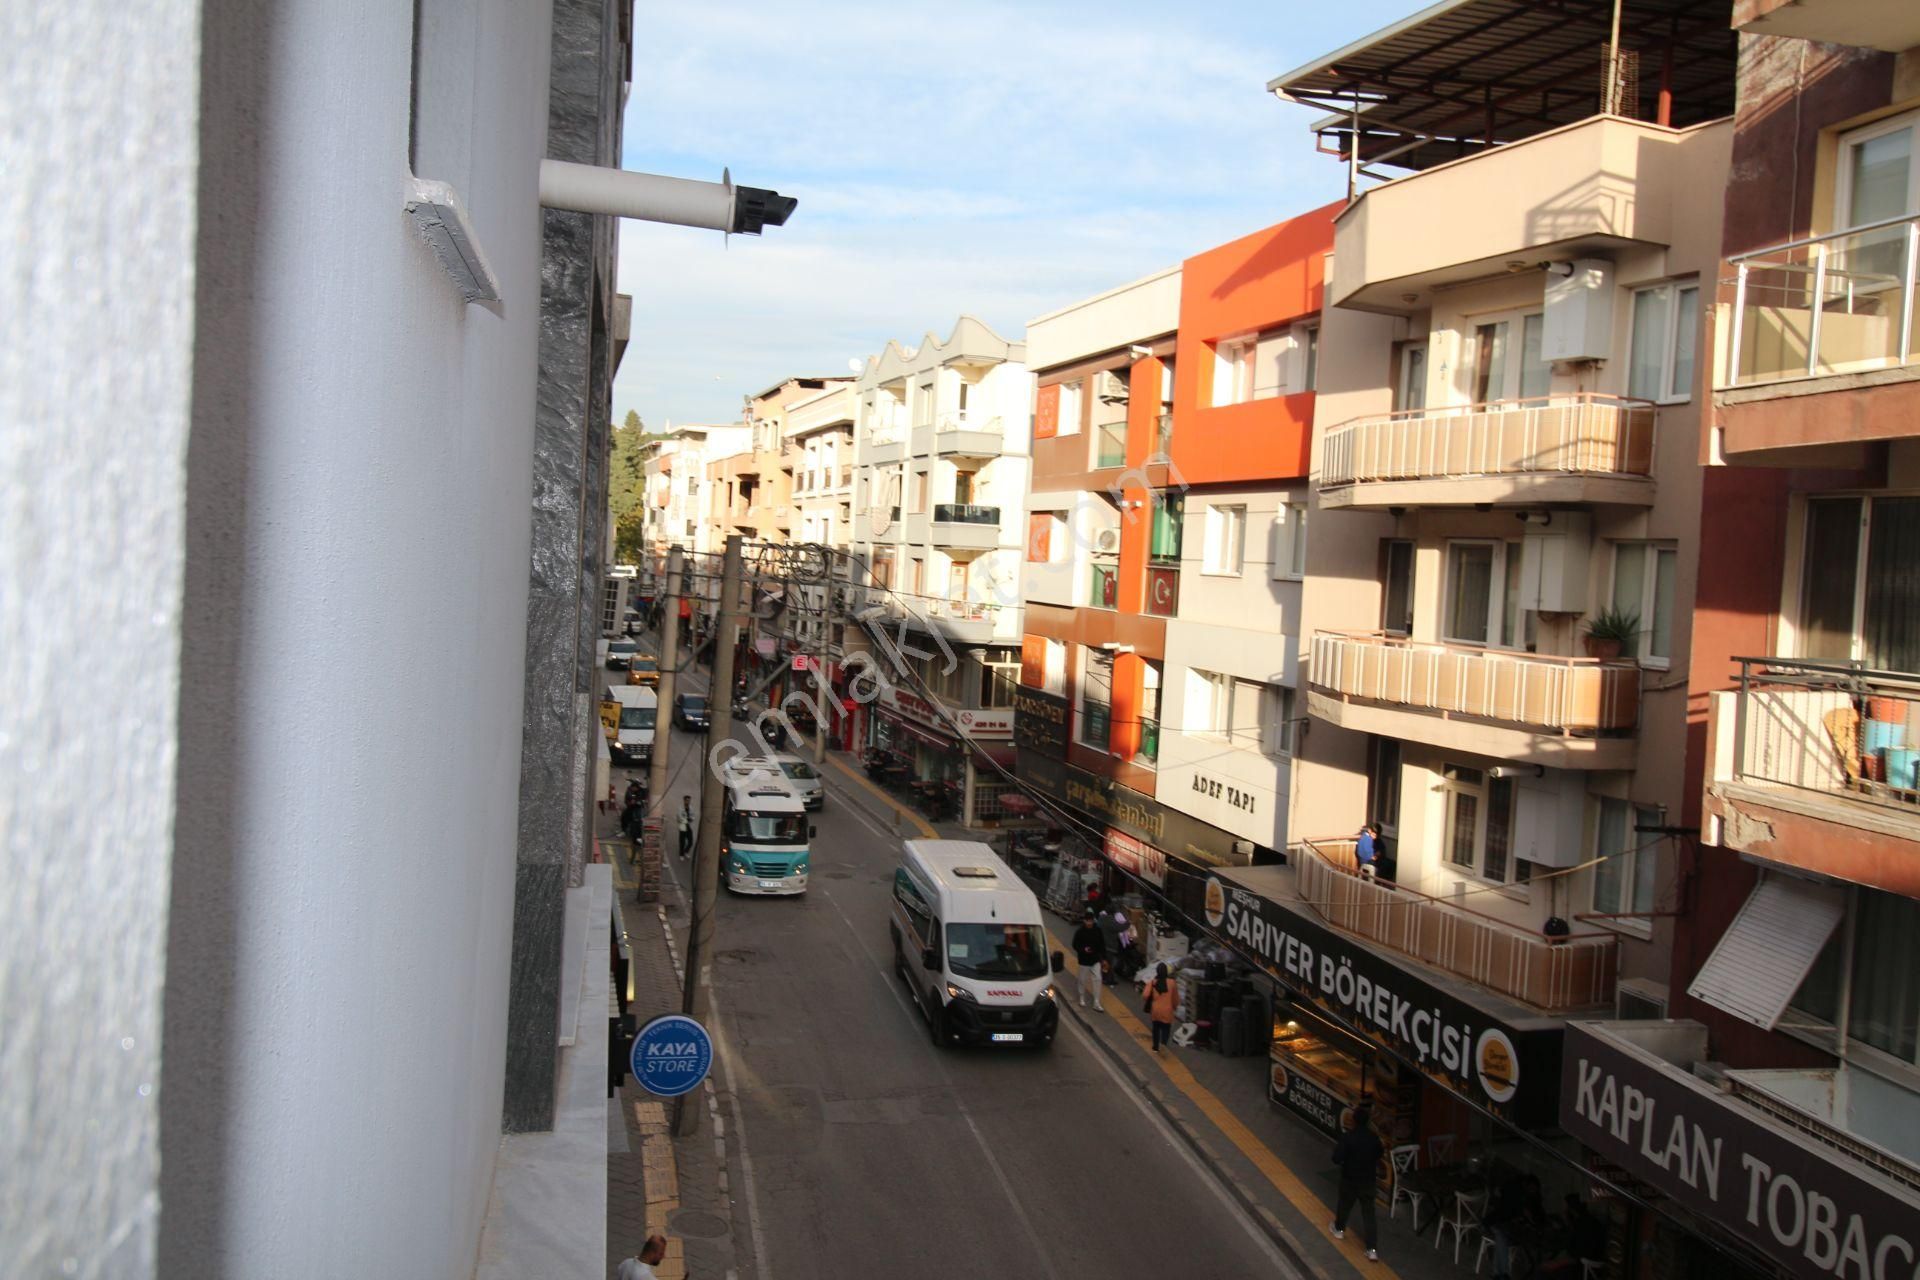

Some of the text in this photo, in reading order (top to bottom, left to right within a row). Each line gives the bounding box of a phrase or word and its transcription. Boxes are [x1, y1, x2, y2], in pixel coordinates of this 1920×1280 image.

[1192, 774, 1255, 814] ADEF YAPI
[1226, 902, 1471, 1080] SARIYER BÖREKÇİSİ
[646, 1060, 697, 1073] STORE
[647, 1042, 697, 1056] KAYA
[1295, 1077, 1332, 1110] SARIYER
[1574, 1058, 1920, 1280] KAPLAN TOBAC
